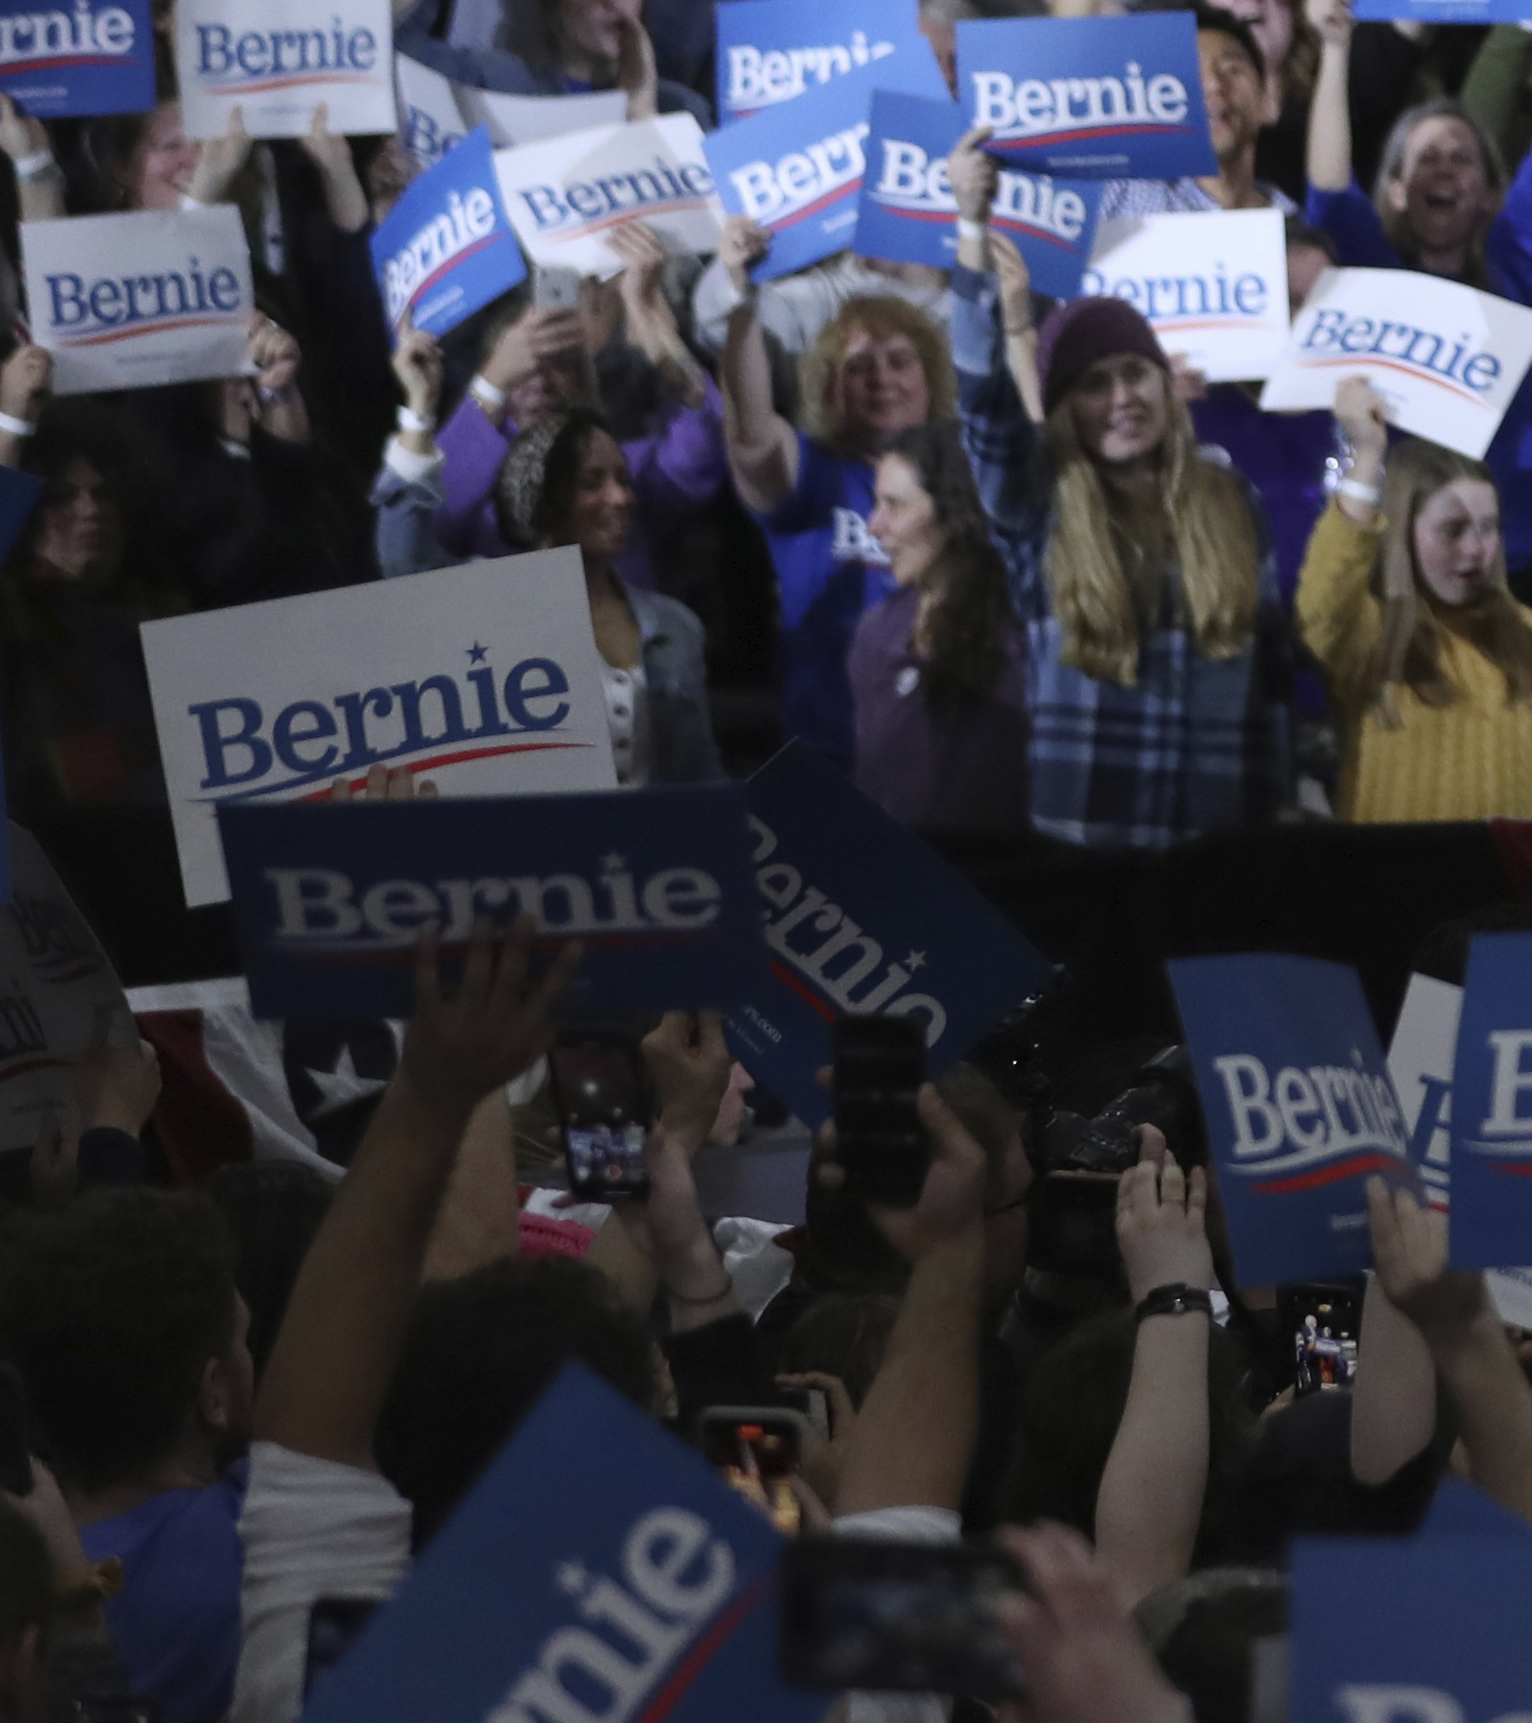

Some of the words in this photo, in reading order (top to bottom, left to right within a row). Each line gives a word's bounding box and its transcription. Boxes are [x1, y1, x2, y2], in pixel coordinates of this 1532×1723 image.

[197, 16, 377, 74] Bernie
[972, 62, 1188, 127] Bernie
[45, 257, 241, 331] Bernie
[1304, 307, 1504, 394] Bernie
[188, 640, 570, 787] Bernie
[264, 853, 720, 938] Bernie
